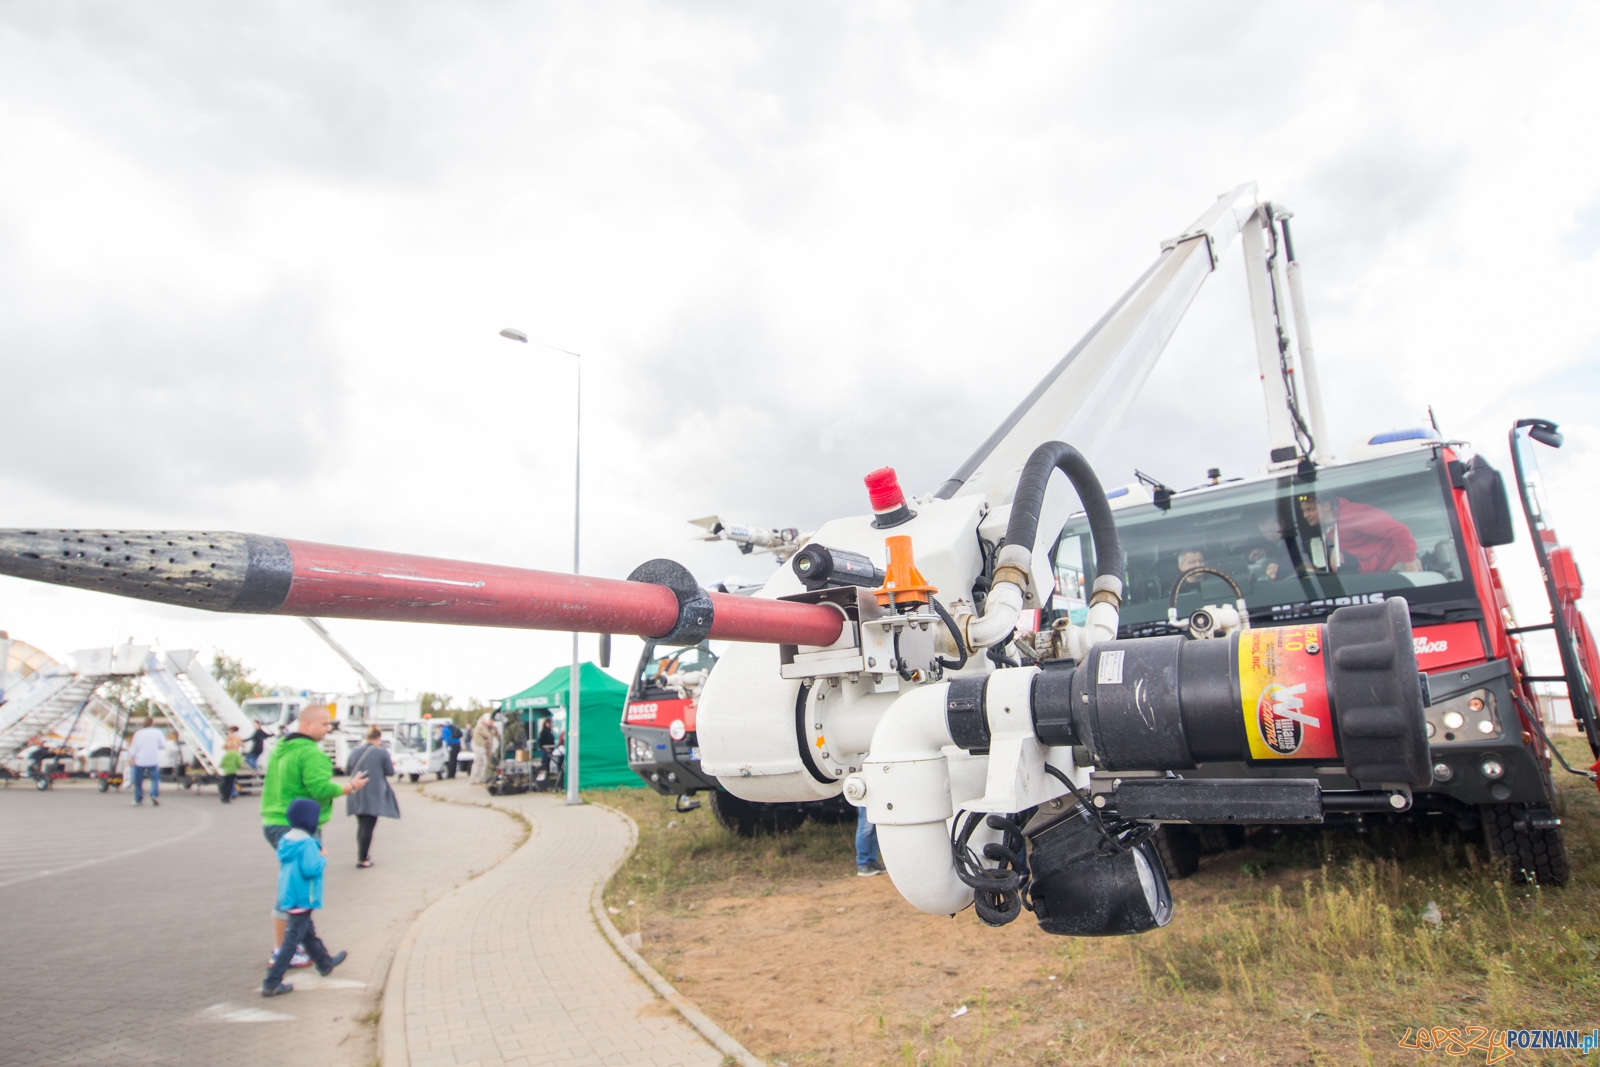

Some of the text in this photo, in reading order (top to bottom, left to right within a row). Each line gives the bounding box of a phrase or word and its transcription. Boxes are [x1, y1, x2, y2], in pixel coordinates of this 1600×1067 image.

[1285, 632, 1304, 651] 1.0
[1304, 625, 1318, 646] HEM
[1413, 636, 1428, 647] ER
[1252, 656, 1260, 672] INC.
[628, 703, 658, 714] IVECO
[1261, 700, 1278, 747] CONTROL
